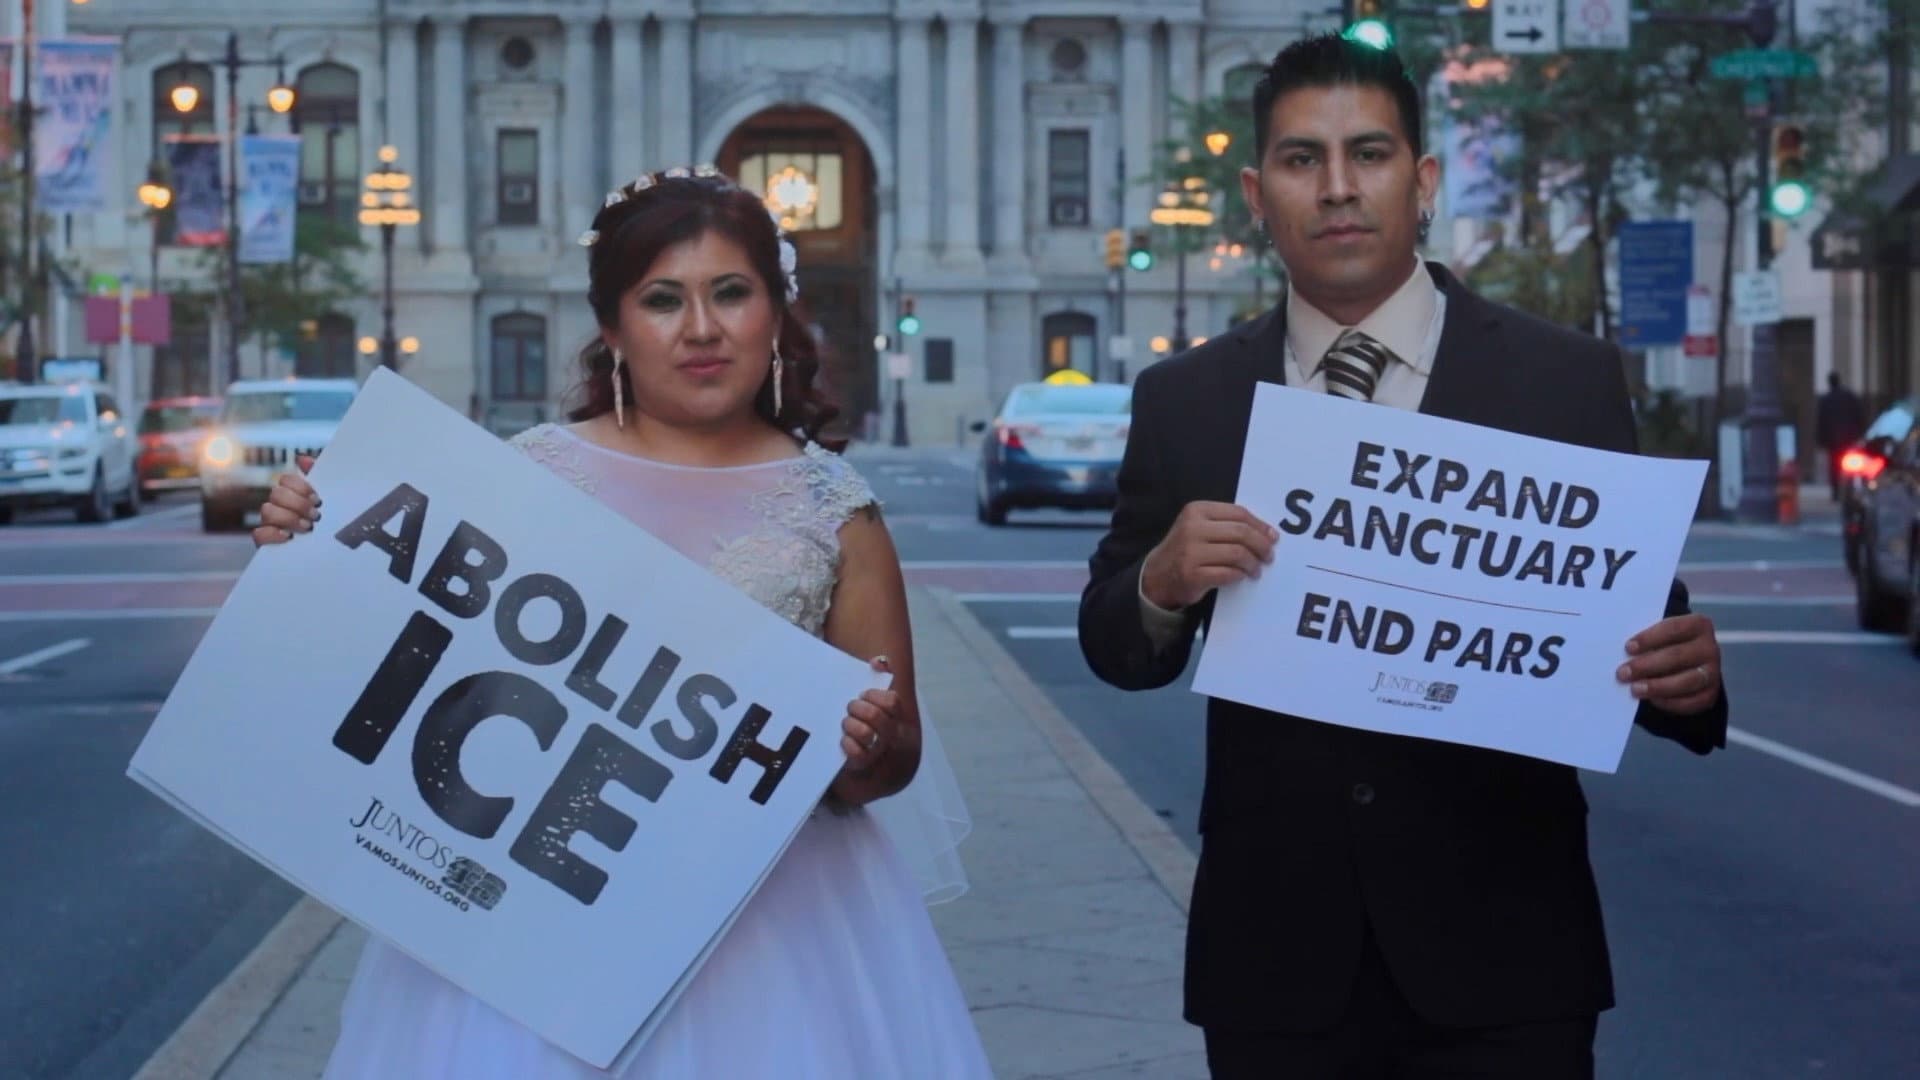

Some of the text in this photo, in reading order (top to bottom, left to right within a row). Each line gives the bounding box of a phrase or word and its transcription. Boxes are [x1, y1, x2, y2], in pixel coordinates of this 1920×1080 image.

[1351, 441, 1600, 529] EXPAND
[1279, 489, 1637, 591] SANCTUARY
[334, 482, 811, 806] ABOLISH
[1296, 592, 1566, 679] END PARS
[332, 610, 675, 906] ICE
[355, 834, 470, 912] VAMOSJUNTOS.ORG
